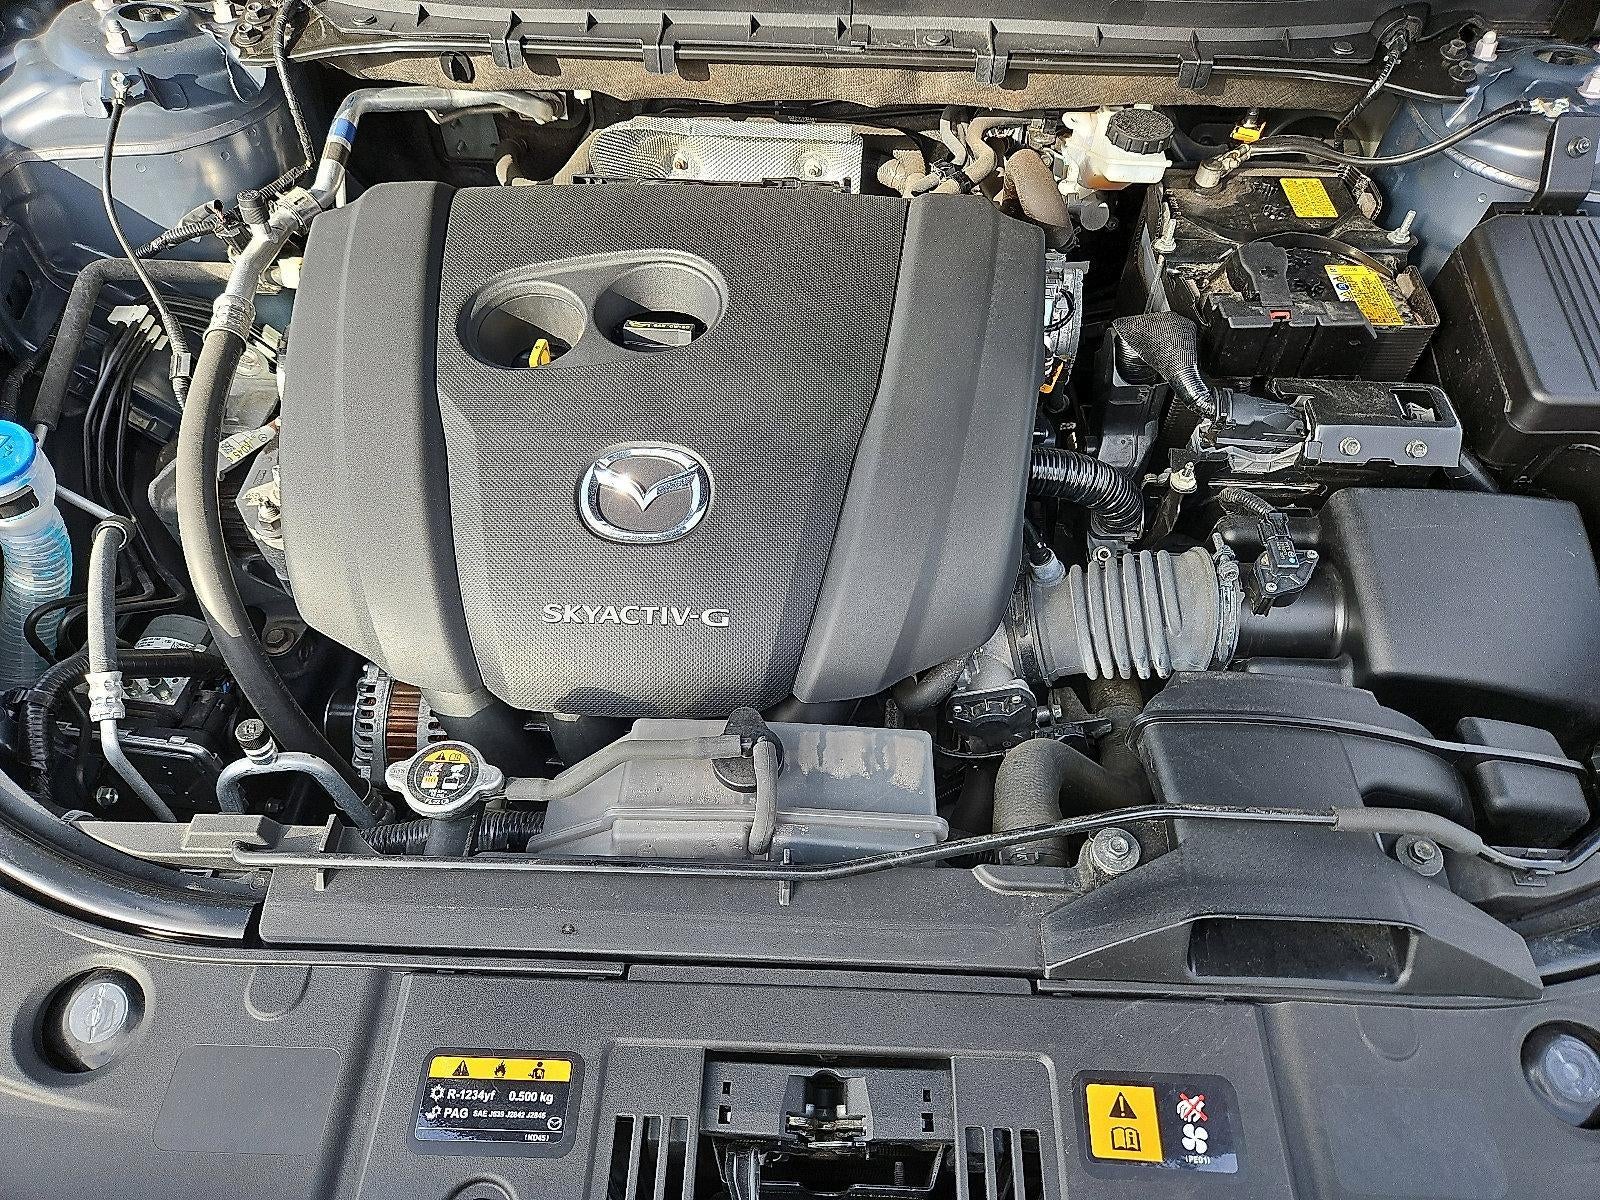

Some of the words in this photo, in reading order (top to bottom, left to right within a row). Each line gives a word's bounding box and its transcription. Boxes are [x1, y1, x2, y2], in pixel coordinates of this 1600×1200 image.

[541, 603, 730, 627] SKYACTIV-G
[447, 1088, 496, 1102] R-1234yf
[508, 1091, 538, 1102] 0.500
[540, 1091, 554, 1105] kg
[444, 1107, 469, 1119] PAG
[472, 1109, 488, 1118] SAE
